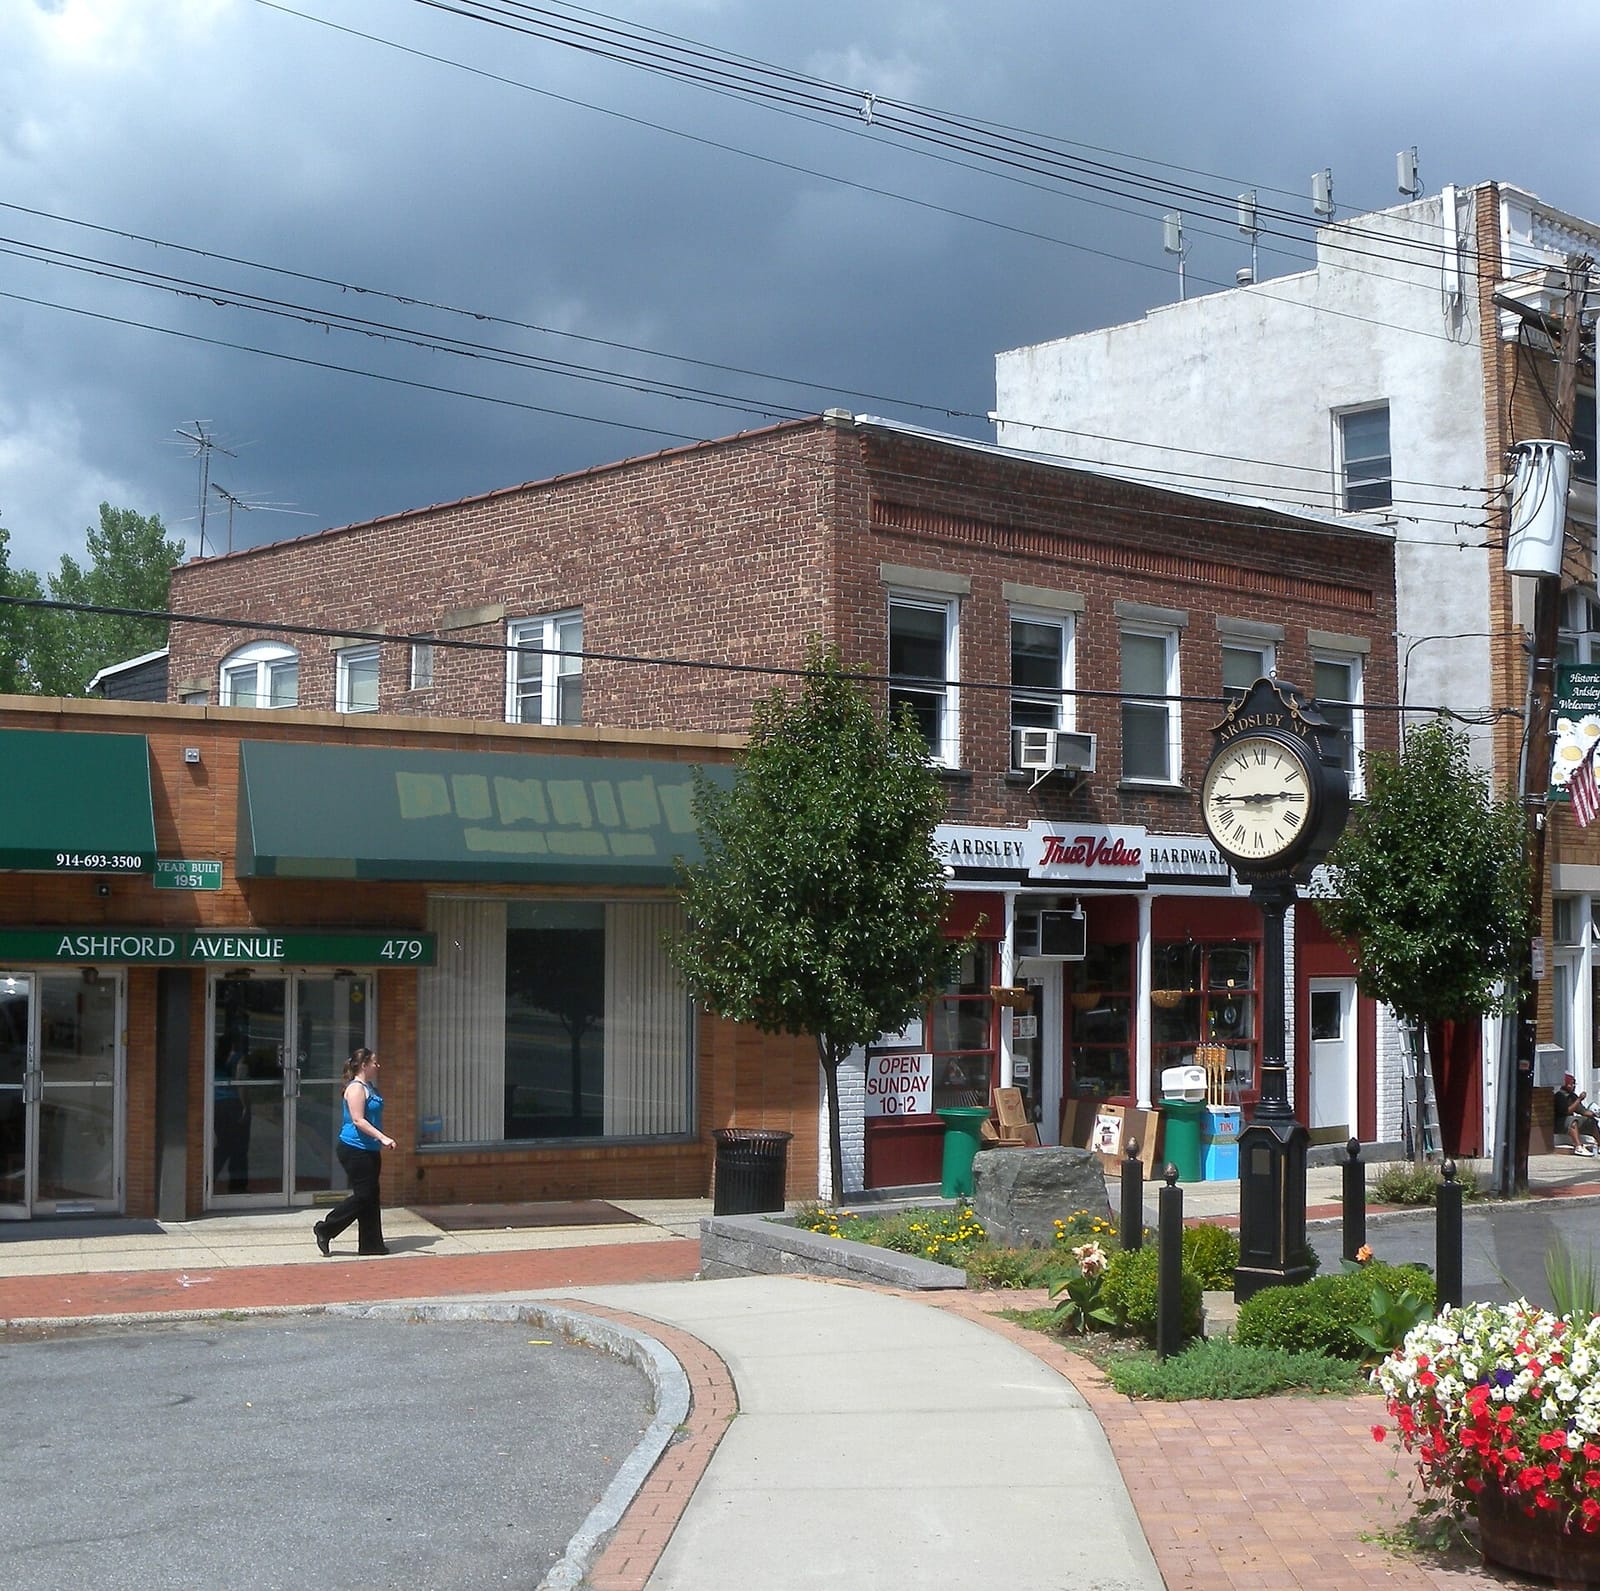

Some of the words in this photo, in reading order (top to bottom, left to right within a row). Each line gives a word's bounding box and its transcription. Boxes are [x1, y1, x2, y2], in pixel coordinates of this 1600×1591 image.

[1570, 673, 1600, 683] Historic
[1572, 686, 1600, 700] Ardsley
[1559, 699, 1597, 710] Welcomes
[1220, 713, 1284, 743] ARDSLEY
[1291, 721, 1310, 736] NY
[951, 839, 1023, 857] ARDSLEY
[56, 853, 142, 869] 914-693-3500
[157, 862, 186, 872] YEAR
[191, 863, 219, 873] BUILT
[174, 875, 203, 886] 1951
[57, 936, 176, 957] ASHFORD
[191, 938, 285, 958] AVENUE
[380, 940, 423, 960] 479
[879, 1056, 921, 1075] OPEN
[867, 1075, 930, 1095] SUNDAY
[880, 1096, 916, 1114] 10-12
